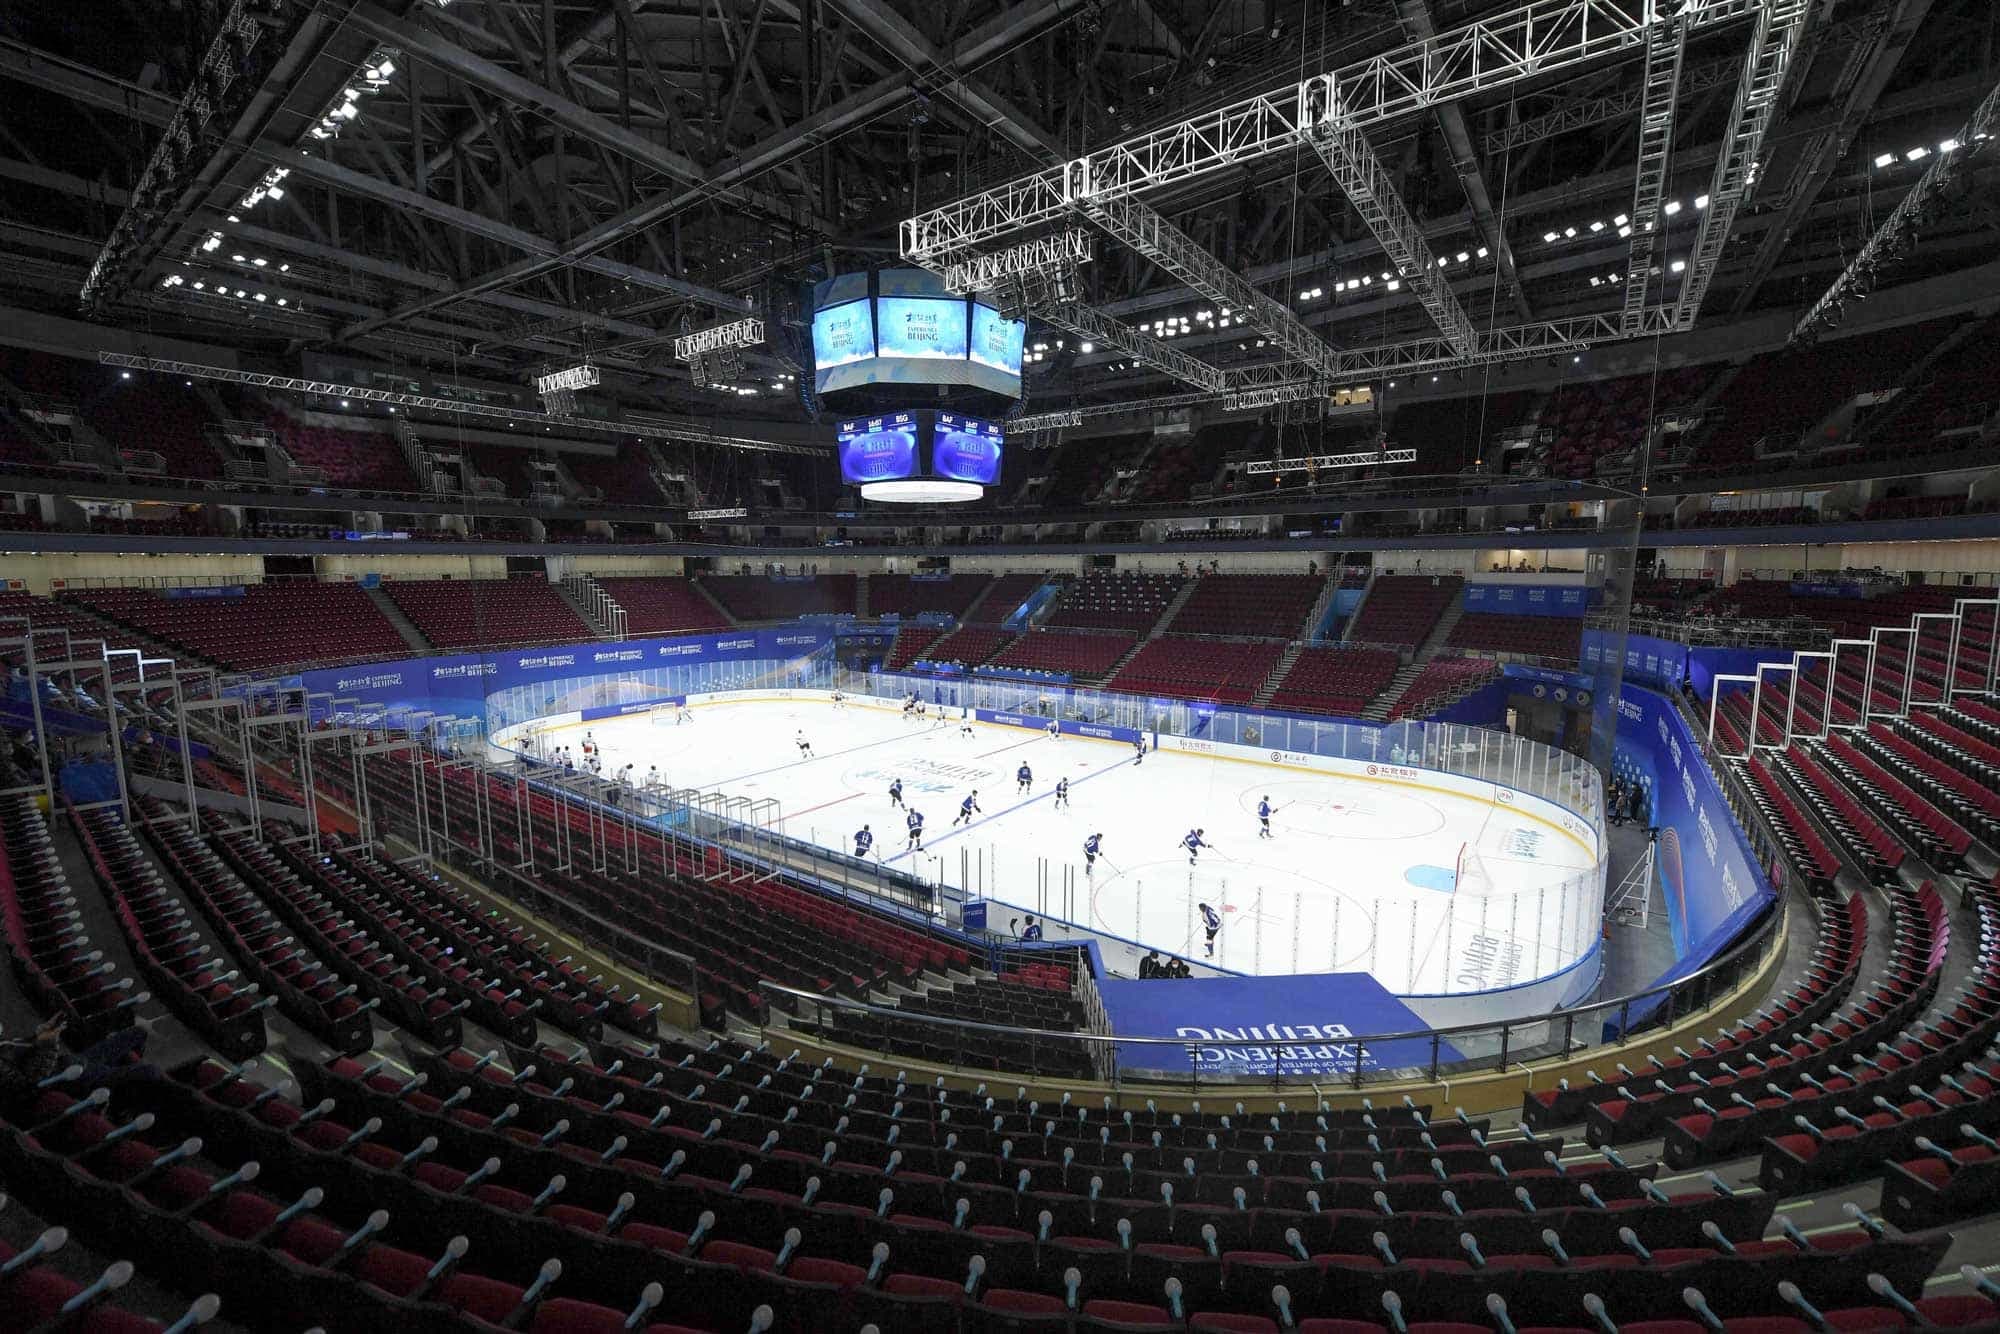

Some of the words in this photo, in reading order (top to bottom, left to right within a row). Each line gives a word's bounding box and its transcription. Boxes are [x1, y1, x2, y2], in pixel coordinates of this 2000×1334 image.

[907, 333, 938, 341] BEIJING
[549, 659, 575, 667] BEIJING
[467, 668, 497, 676] BEIJING
[372, 680, 402, 689] BEIJING
[1176, 1024, 1353, 1041] BEIJING
